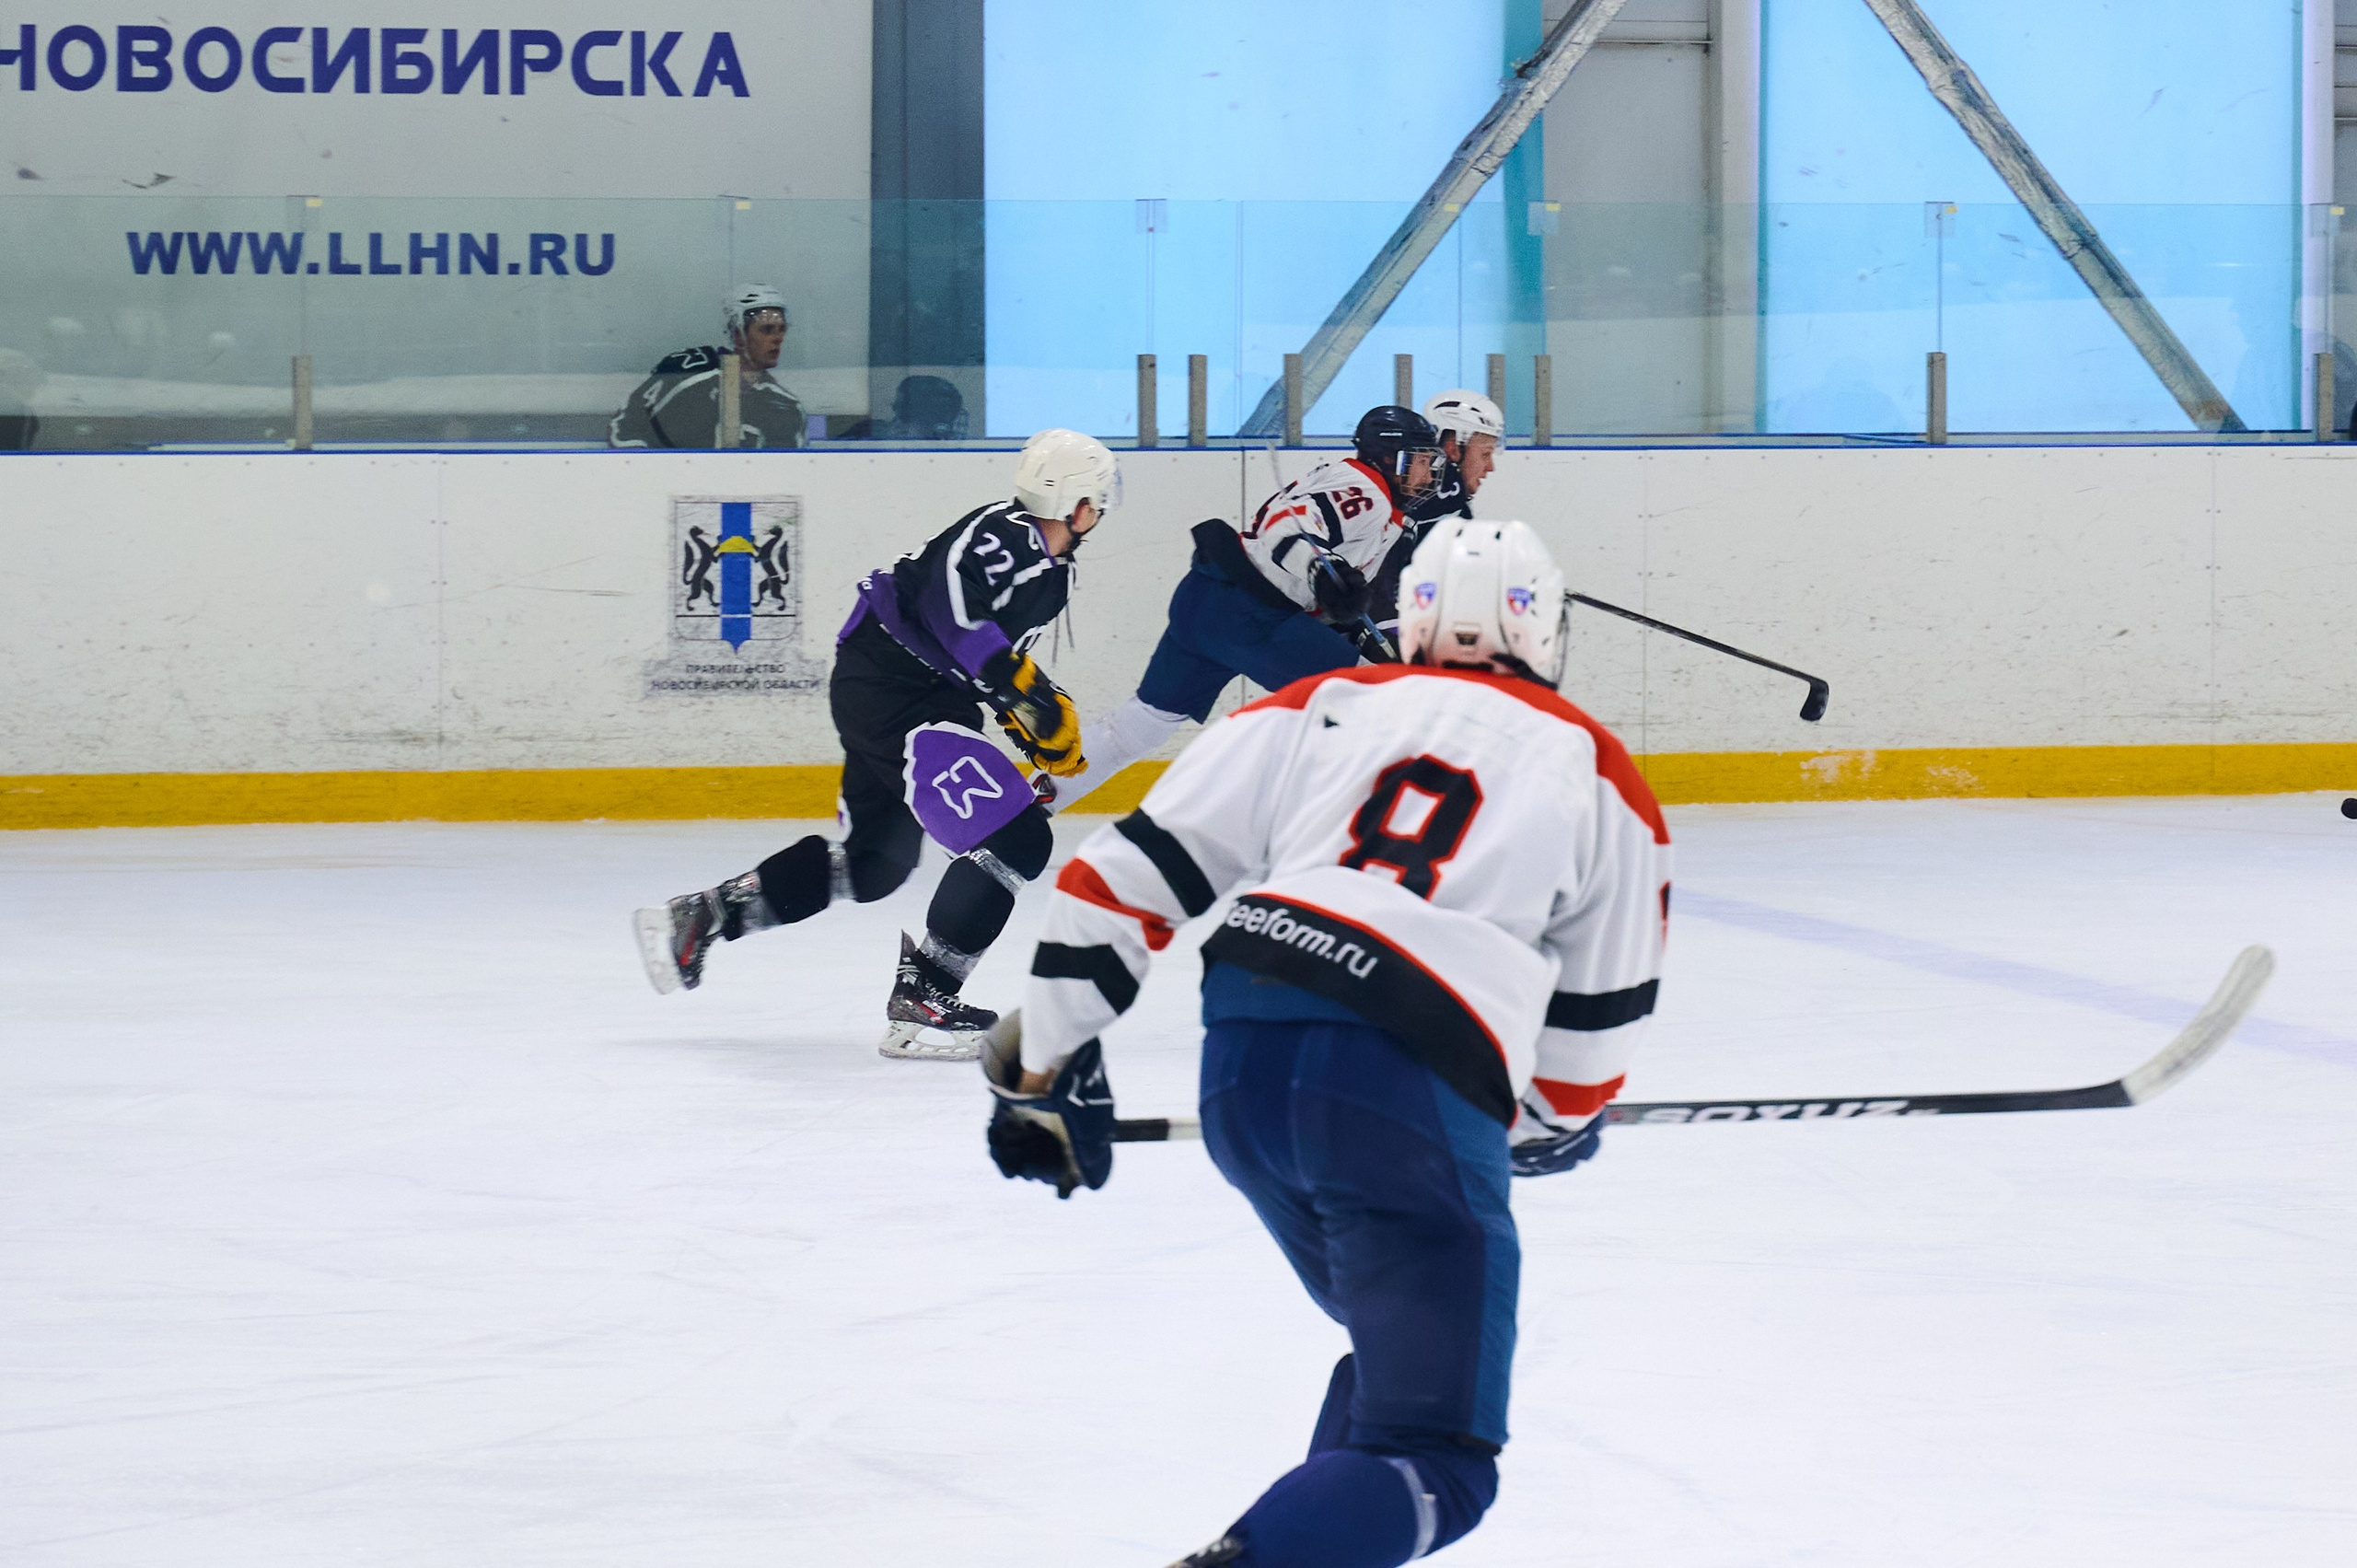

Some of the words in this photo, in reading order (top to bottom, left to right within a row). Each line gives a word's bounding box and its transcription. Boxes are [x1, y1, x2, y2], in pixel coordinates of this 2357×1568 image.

[0, 24, 750, 98] НОВОСИБИРСКА
[126, 231, 615, 275] WWW.LLHN.RU
[1331, 486, 1374, 520] 26
[972, 531, 1016, 587] 22
[1339, 753, 1484, 901] 8
[1226, 900, 1379, 980] eeform.ru
